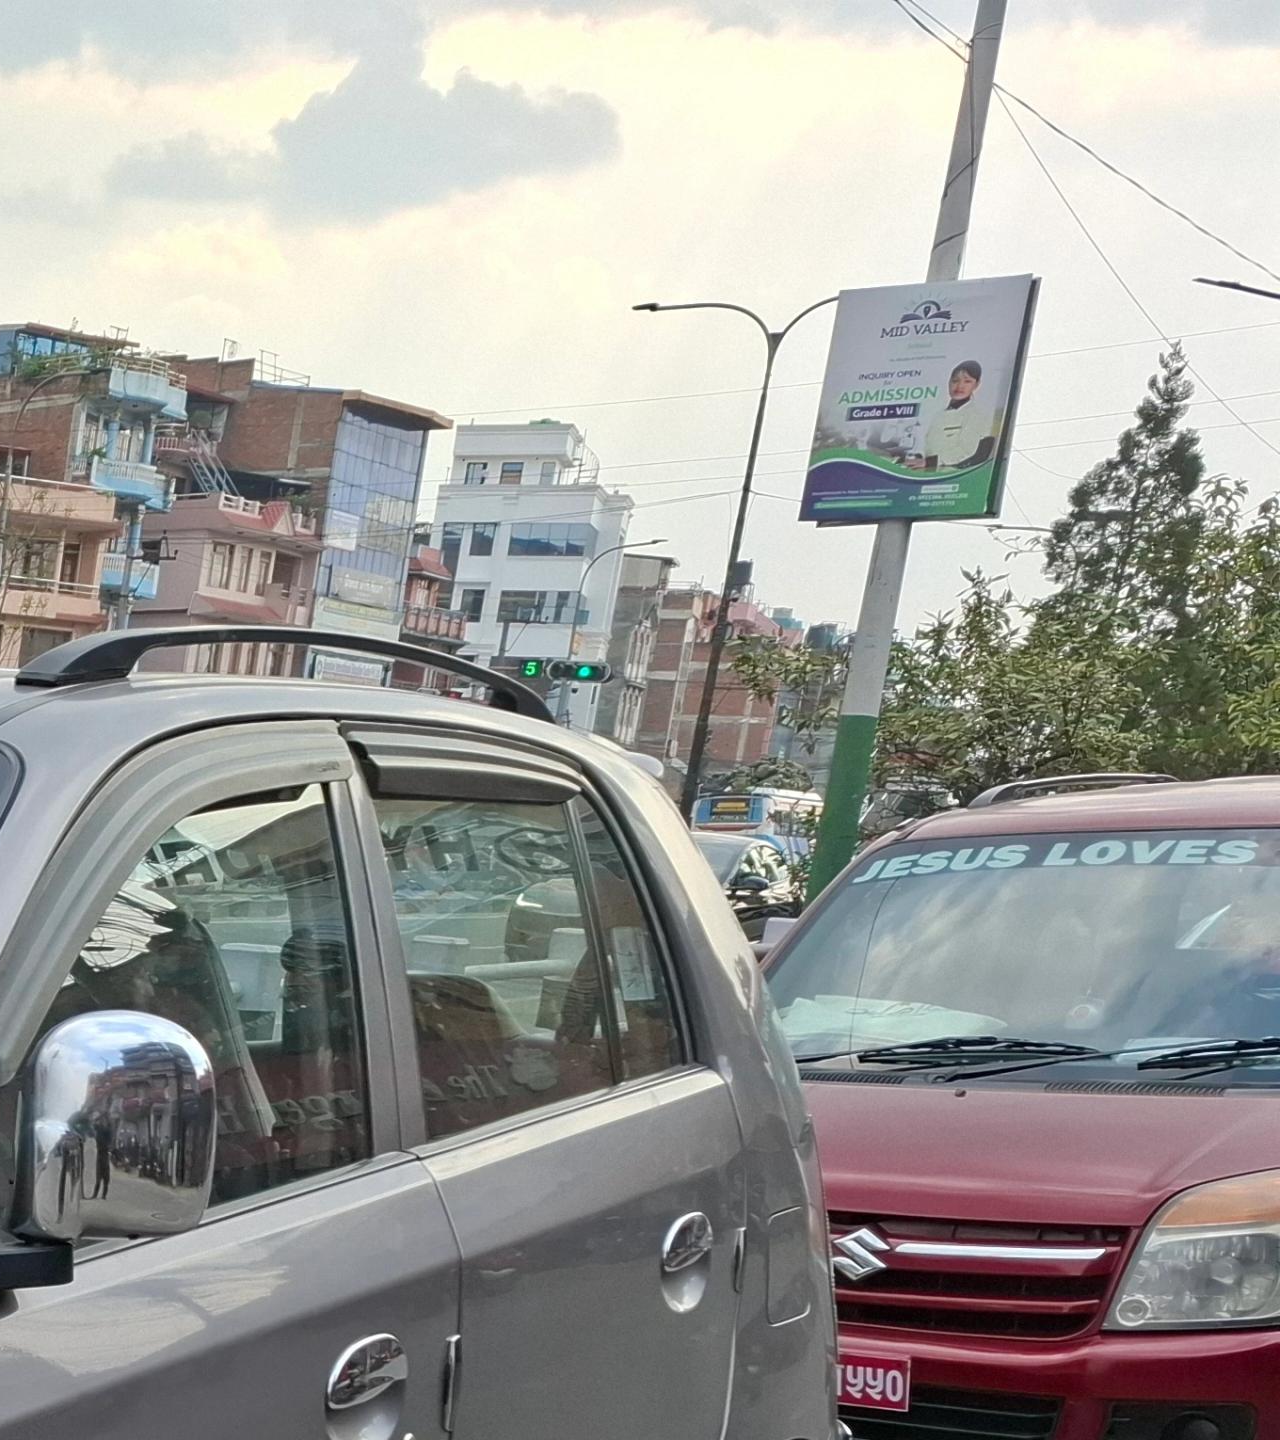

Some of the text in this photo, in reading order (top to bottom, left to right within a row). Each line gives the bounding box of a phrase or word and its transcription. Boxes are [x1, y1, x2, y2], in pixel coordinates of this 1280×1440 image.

[880, 320, 969, 339] MID VALLEY
[896, 369, 922, 378] OPEN
[838, 385, 938, 405] ADMISSION
[852, 407, 881, 418] Grade
[525, 661, 537, 676] 5
[852, 839, 1260, 884] JESUS LOVES
